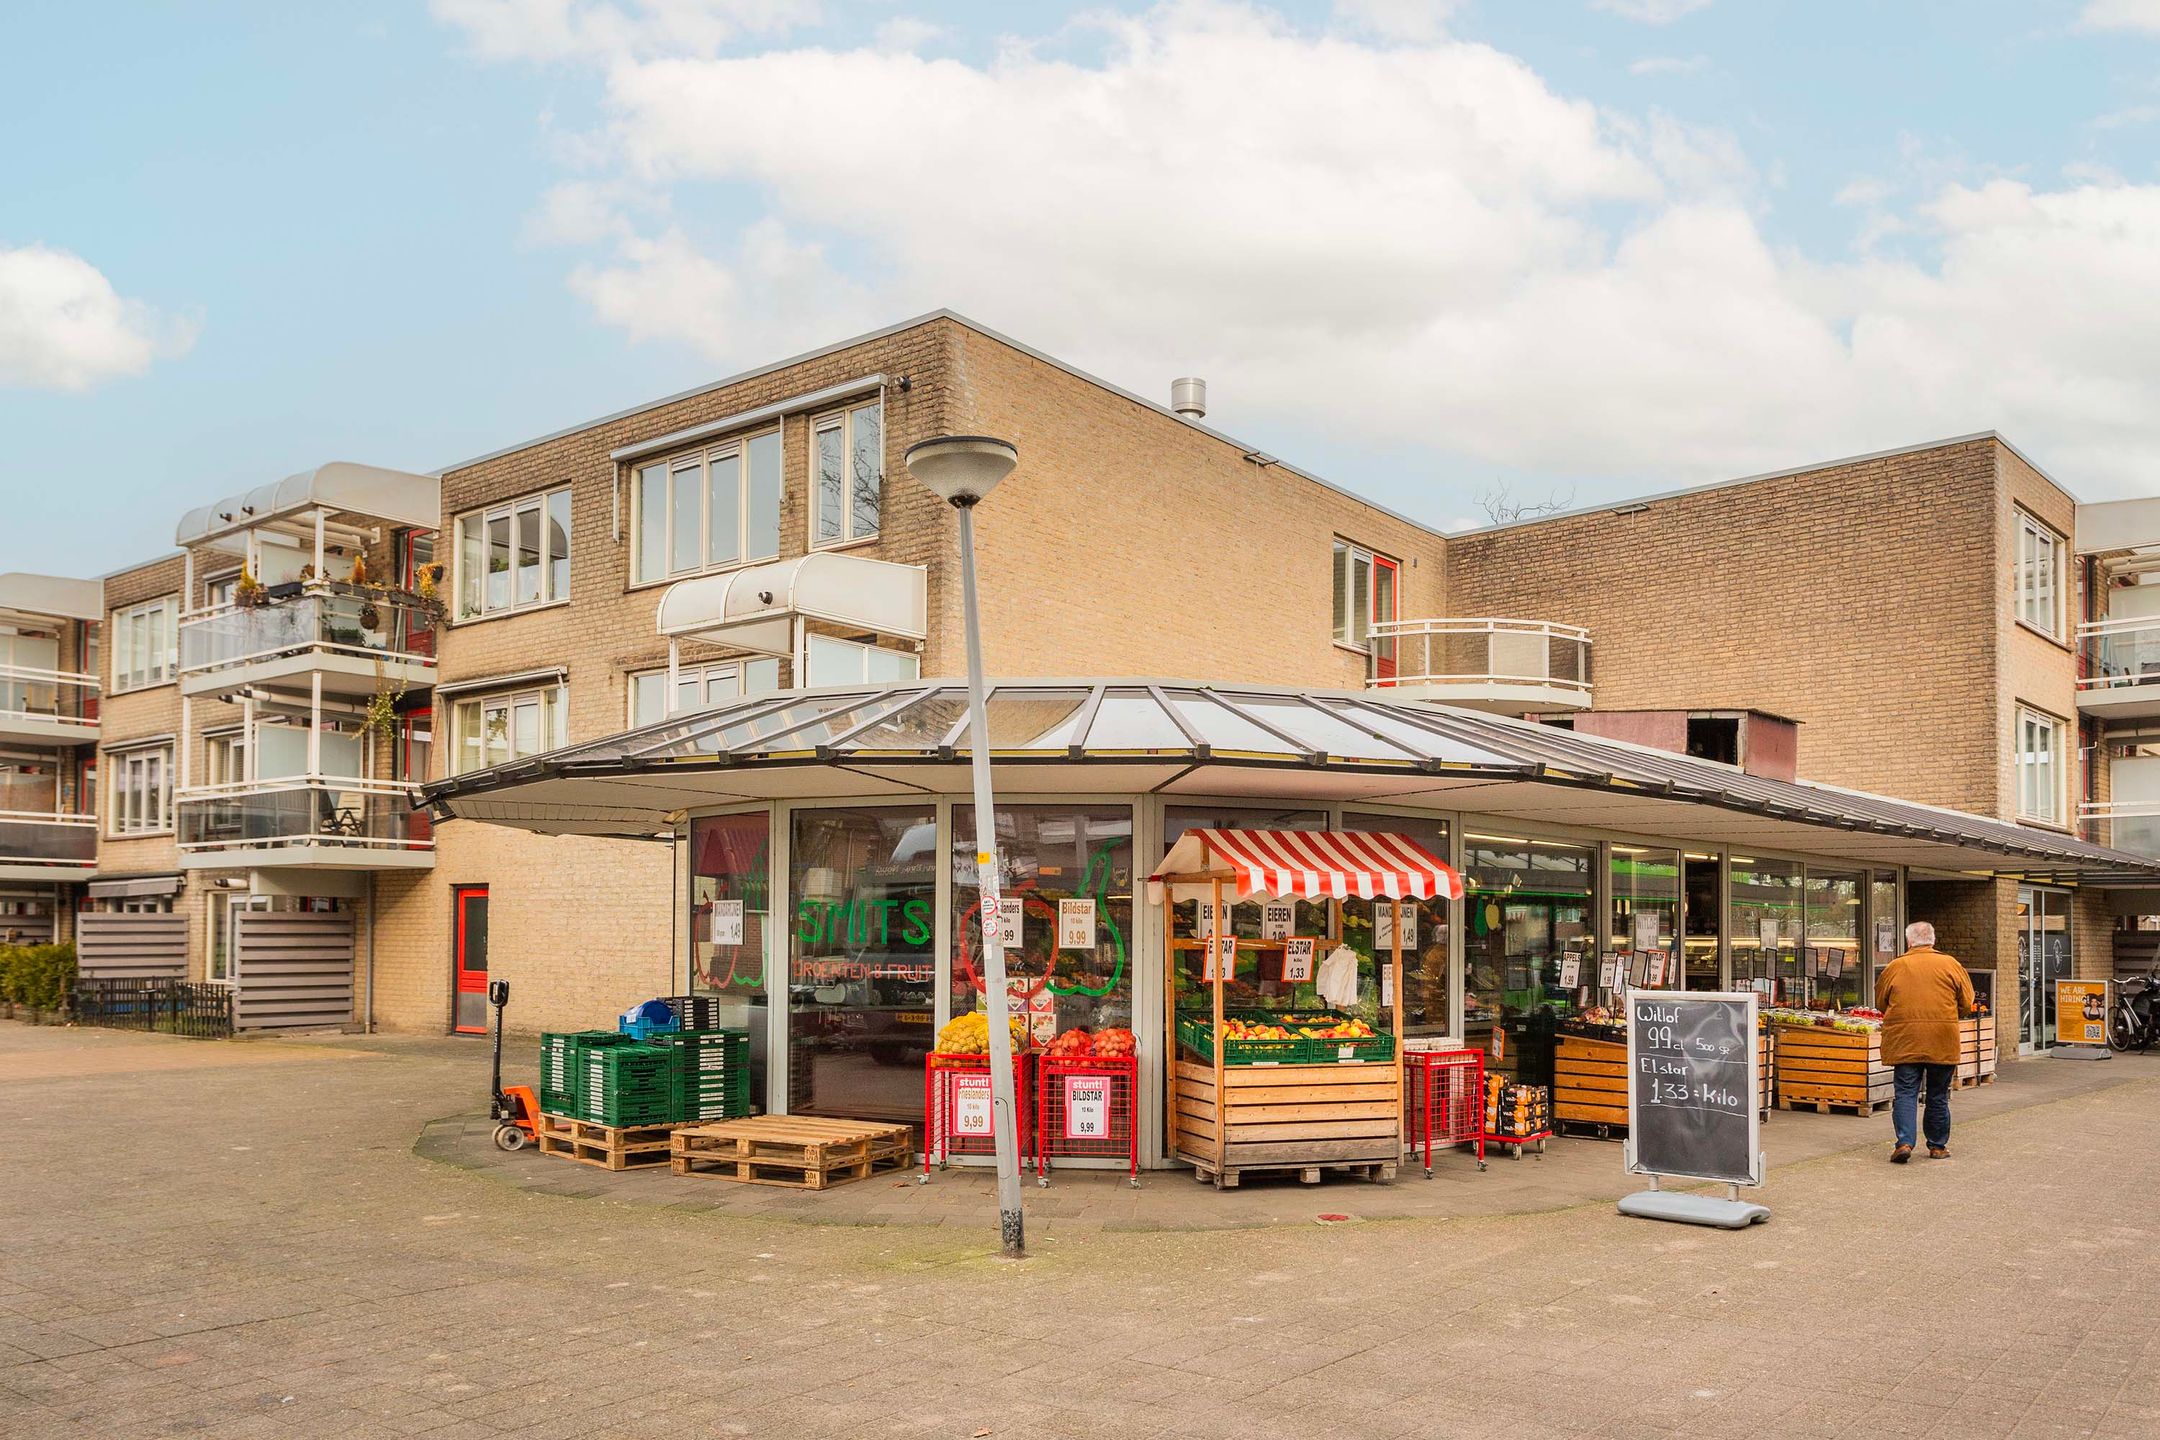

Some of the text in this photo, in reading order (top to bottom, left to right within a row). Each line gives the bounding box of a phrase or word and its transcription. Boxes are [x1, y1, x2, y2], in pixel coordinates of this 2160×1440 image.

[1062, 902, 1092, 914] Bildstar
[1267, 908, 1292, 922] EIEREN
[798, 899, 930, 945] SMITS
[1287, 941, 1312, 955] ELSTAR
[1564, 952, 1581, 963] APPELS
[887, 963, 933, 981] FRUIT
[1289, 967, 1305, 980] 1,33
[2060, 985, 2086, 995] WE ARE
[1636, 1006, 1682, 1023] Witlof
[1647, 1026, 1672, 1049] 99
[1695, 1037, 1715, 1052] 500
[1640, 1057, 1689, 1076] Elstar
[960, 1078, 989, 1087] stunt!
[1072, 1080, 1103, 1089] stunt!
[1072, 1091, 1103, 1101] BILDSTAR
[964, 1115, 984, 1129] 9,99
